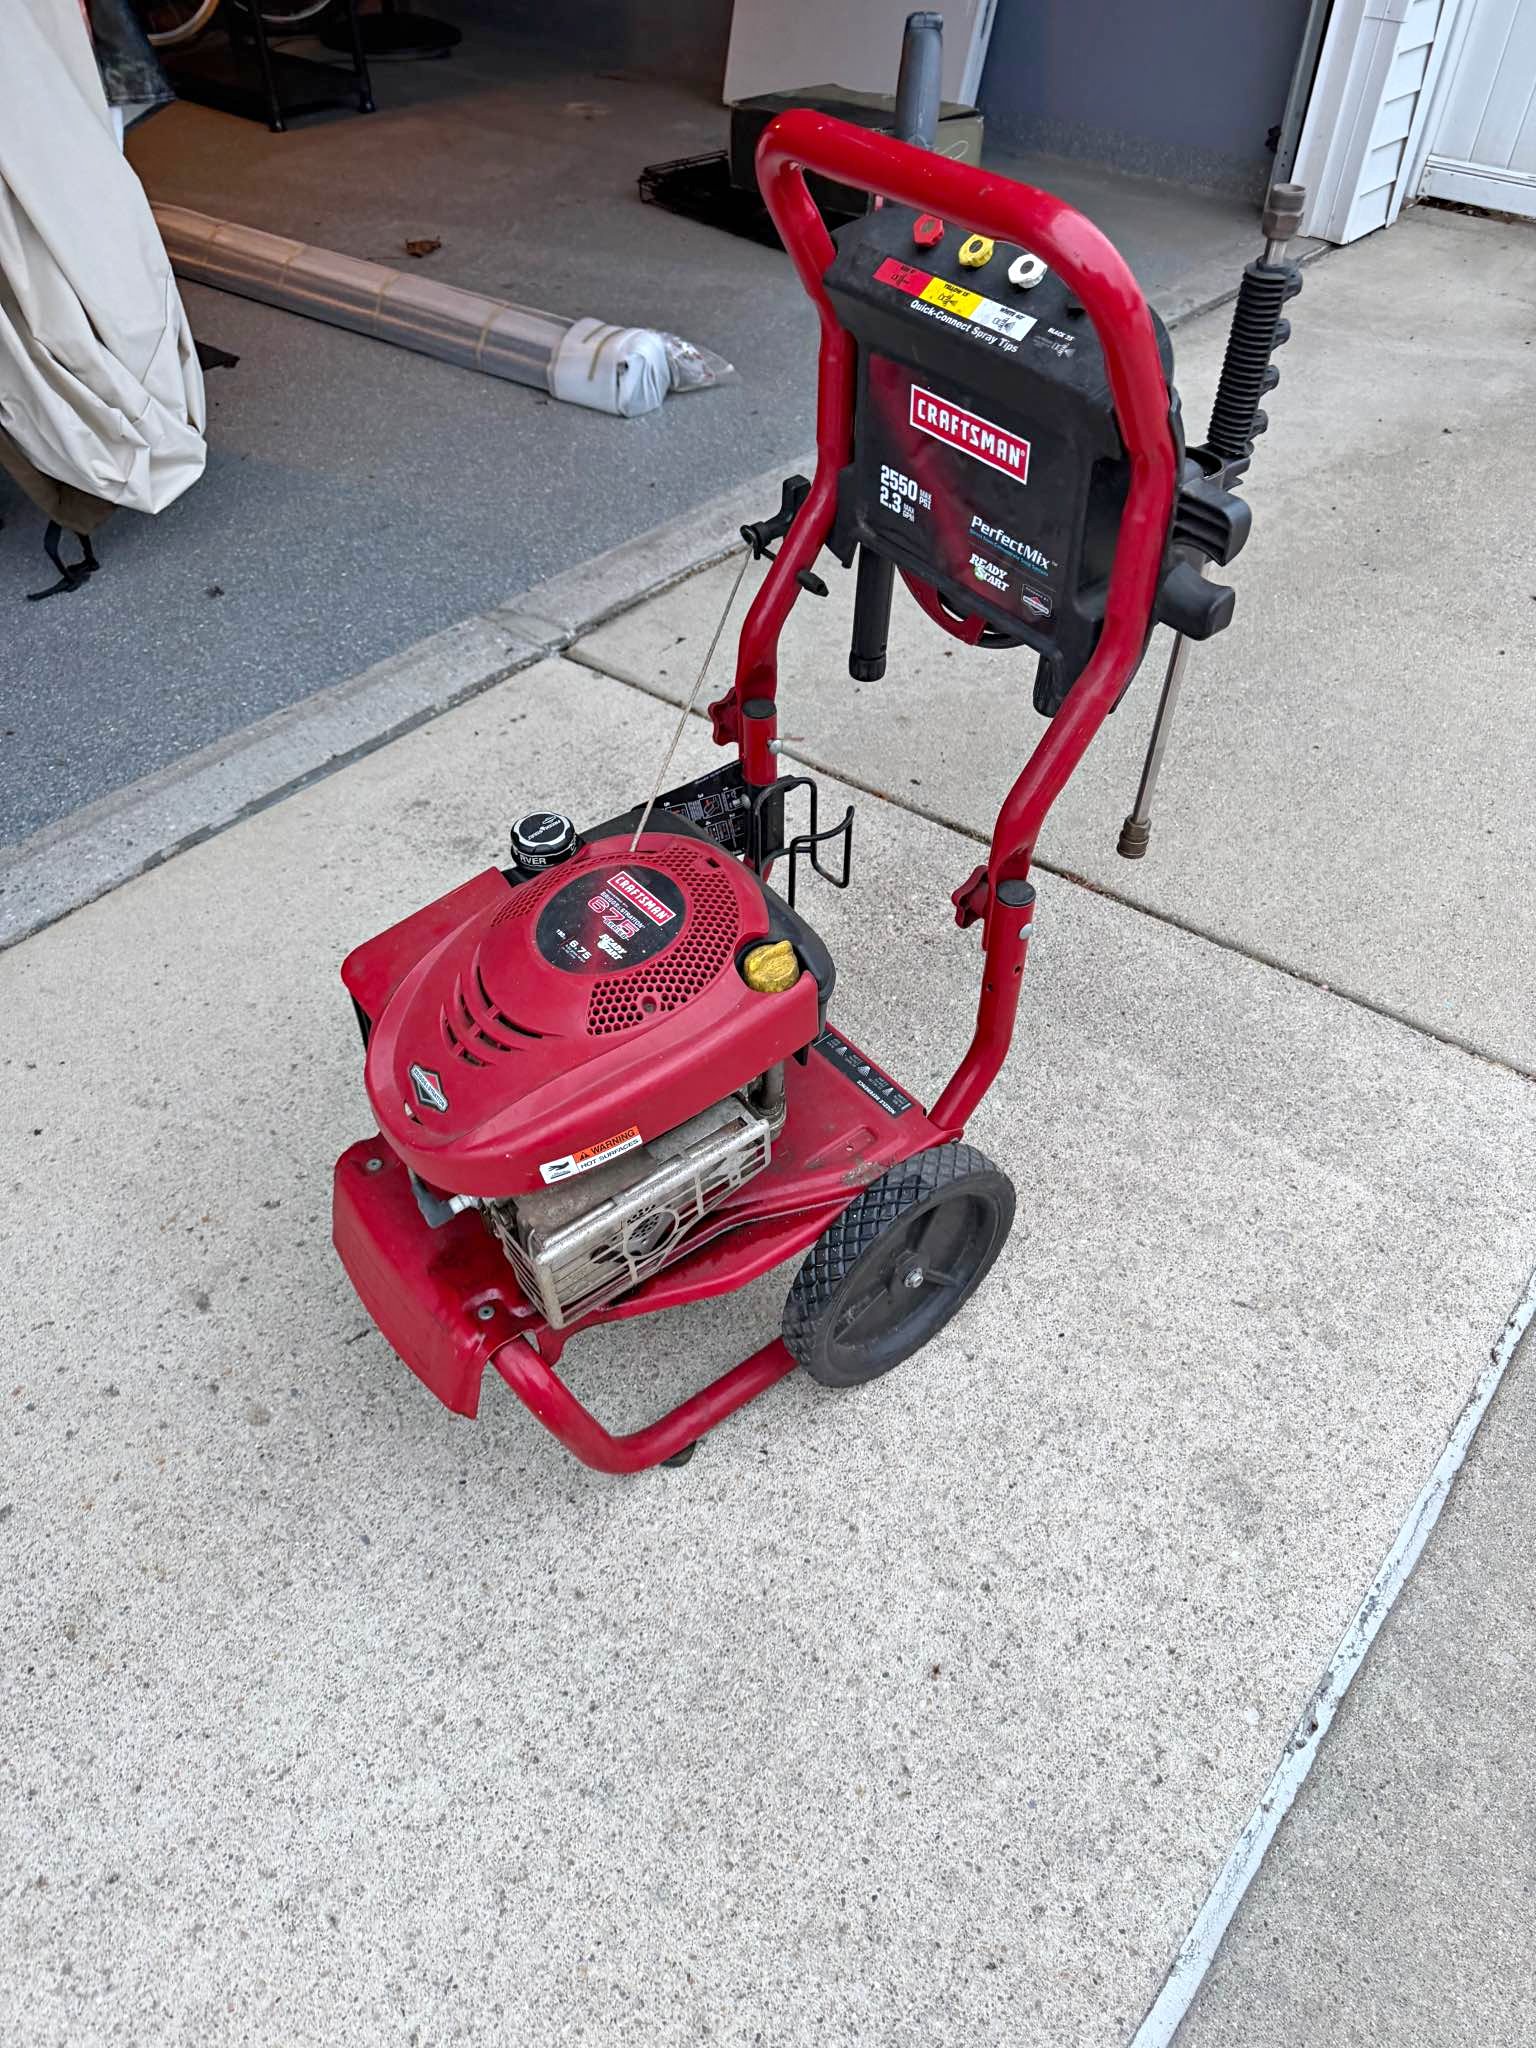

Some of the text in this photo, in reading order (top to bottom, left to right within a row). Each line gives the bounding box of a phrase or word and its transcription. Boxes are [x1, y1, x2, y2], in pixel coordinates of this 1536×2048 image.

[910, 299, 972, 332] Quick-Connect
[971, 326, 998, 345] Spray
[998, 338, 1019, 353] Tips
[917, 398, 1020, 469] CRAFTSMAN
[881, 464, 918, 501] 2550
[880, 485, 901, 514] 2.3
[919, 497, 932, 510] PSI
[971, 515, 1051, 570] PerfectMix
[969, 553, 1008, 580] READY
[975, 566, 1010, 592] START
[615, 876, 668, 921] CRAFTSMAN
[588, 896, 640, 938] 675
[569, 940, 592, 960] 6.75
[580, 1139, 640, 1169] HOT SURFACES
[591, 1129, 636, 1154] WARNING
